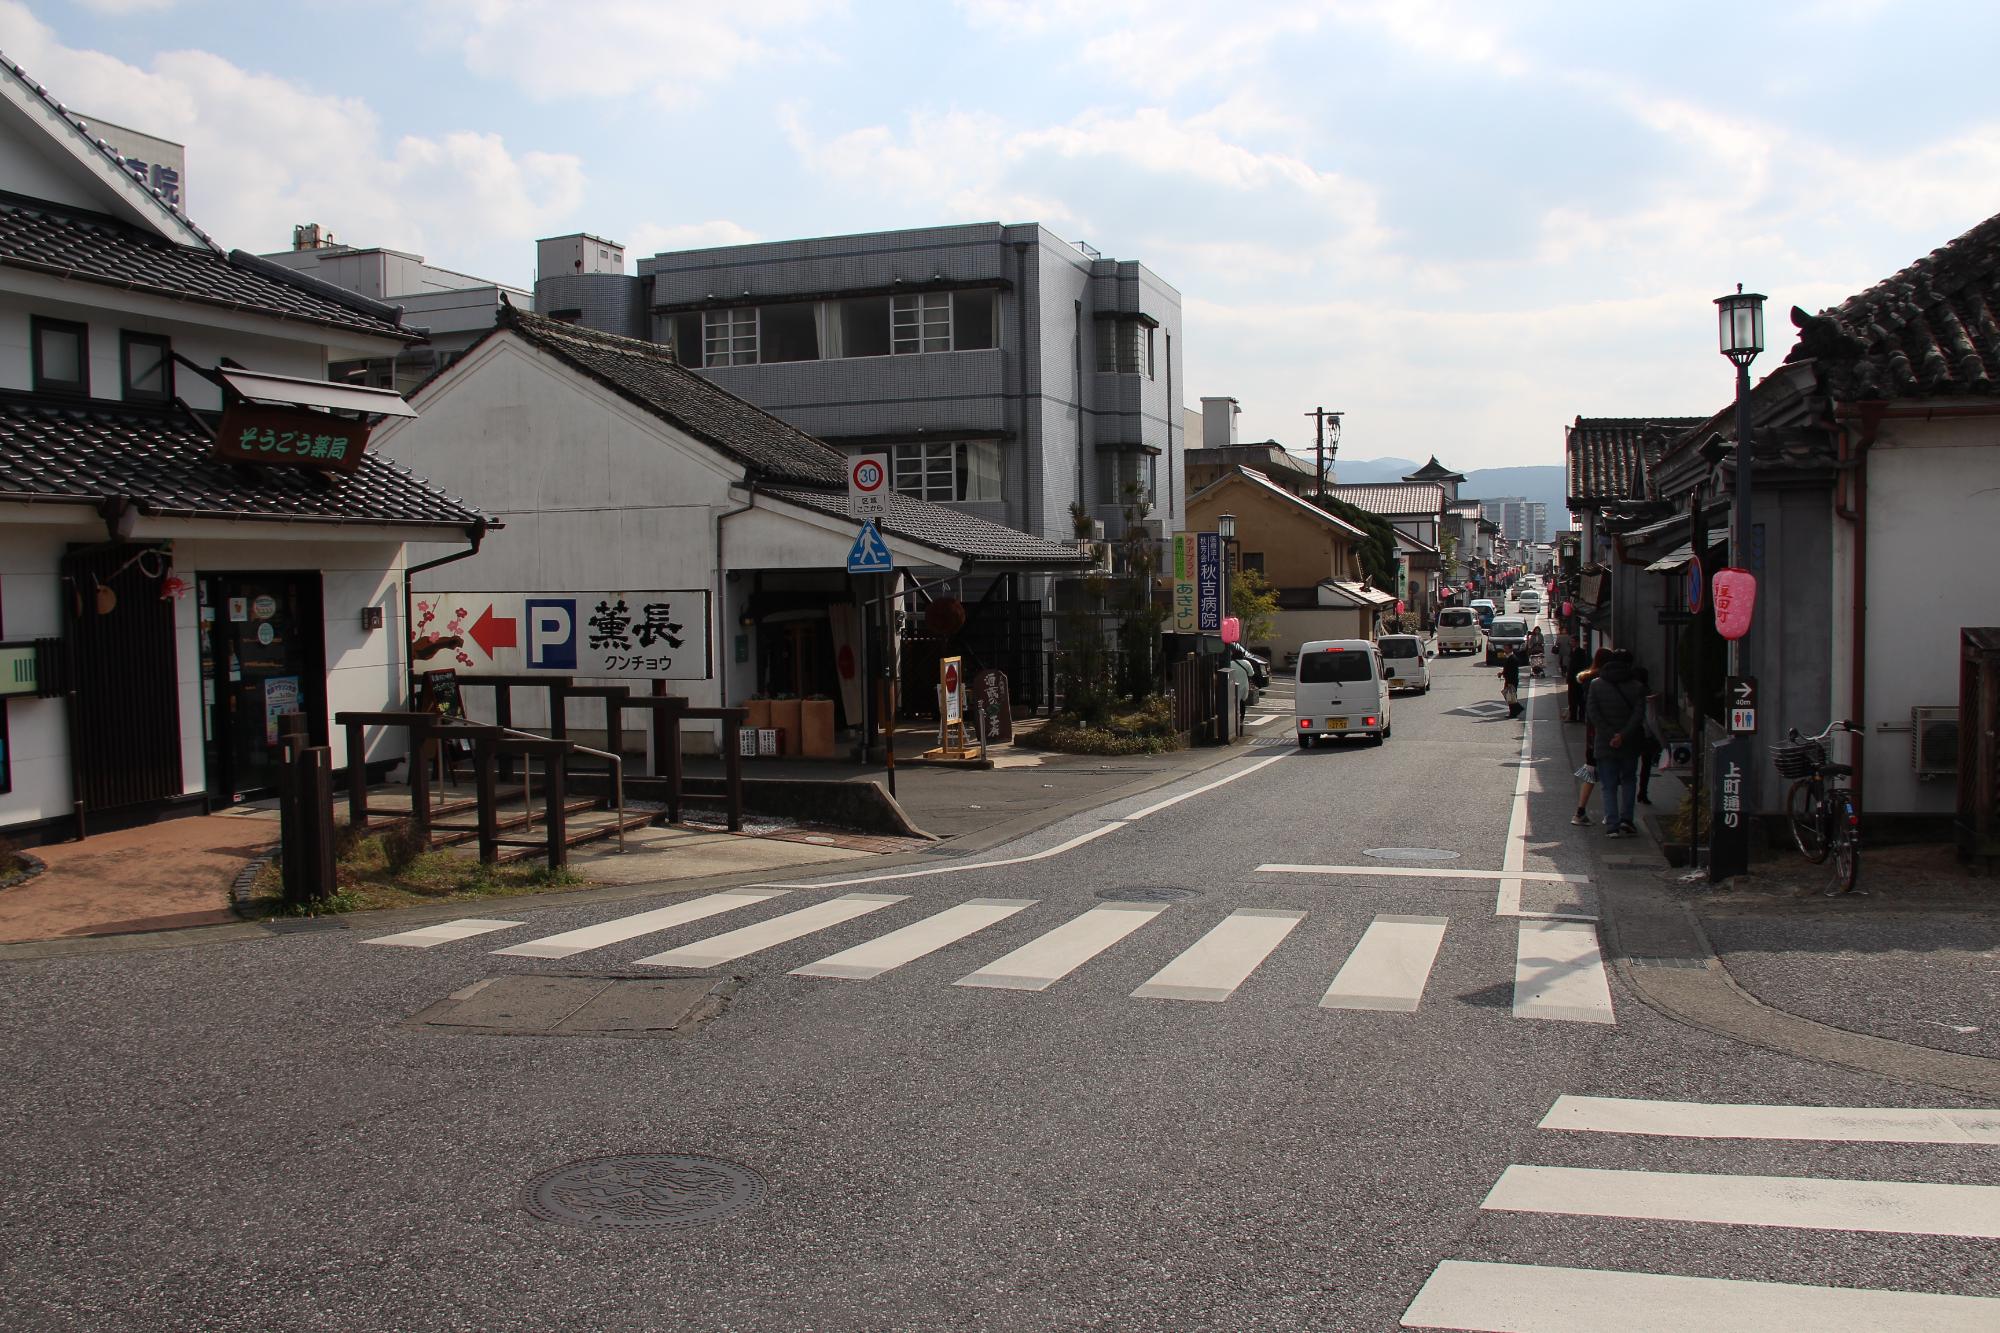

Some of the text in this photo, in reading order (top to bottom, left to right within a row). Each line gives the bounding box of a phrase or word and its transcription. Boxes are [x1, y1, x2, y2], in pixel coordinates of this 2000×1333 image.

[239, 426, 349, 460] そうごう薬局
[860, 469, 876, 483] 30
[857, 505, 883, 513] ここから
[1176, 583, 1193, 630] あきよし
[1200, 563, 1217, 628] 秋吉病院
[532, 605, 571, 663] P
[604, 655, 673, 671] クンチョウ
[1723, 761, 1741, 828] 上町通り
